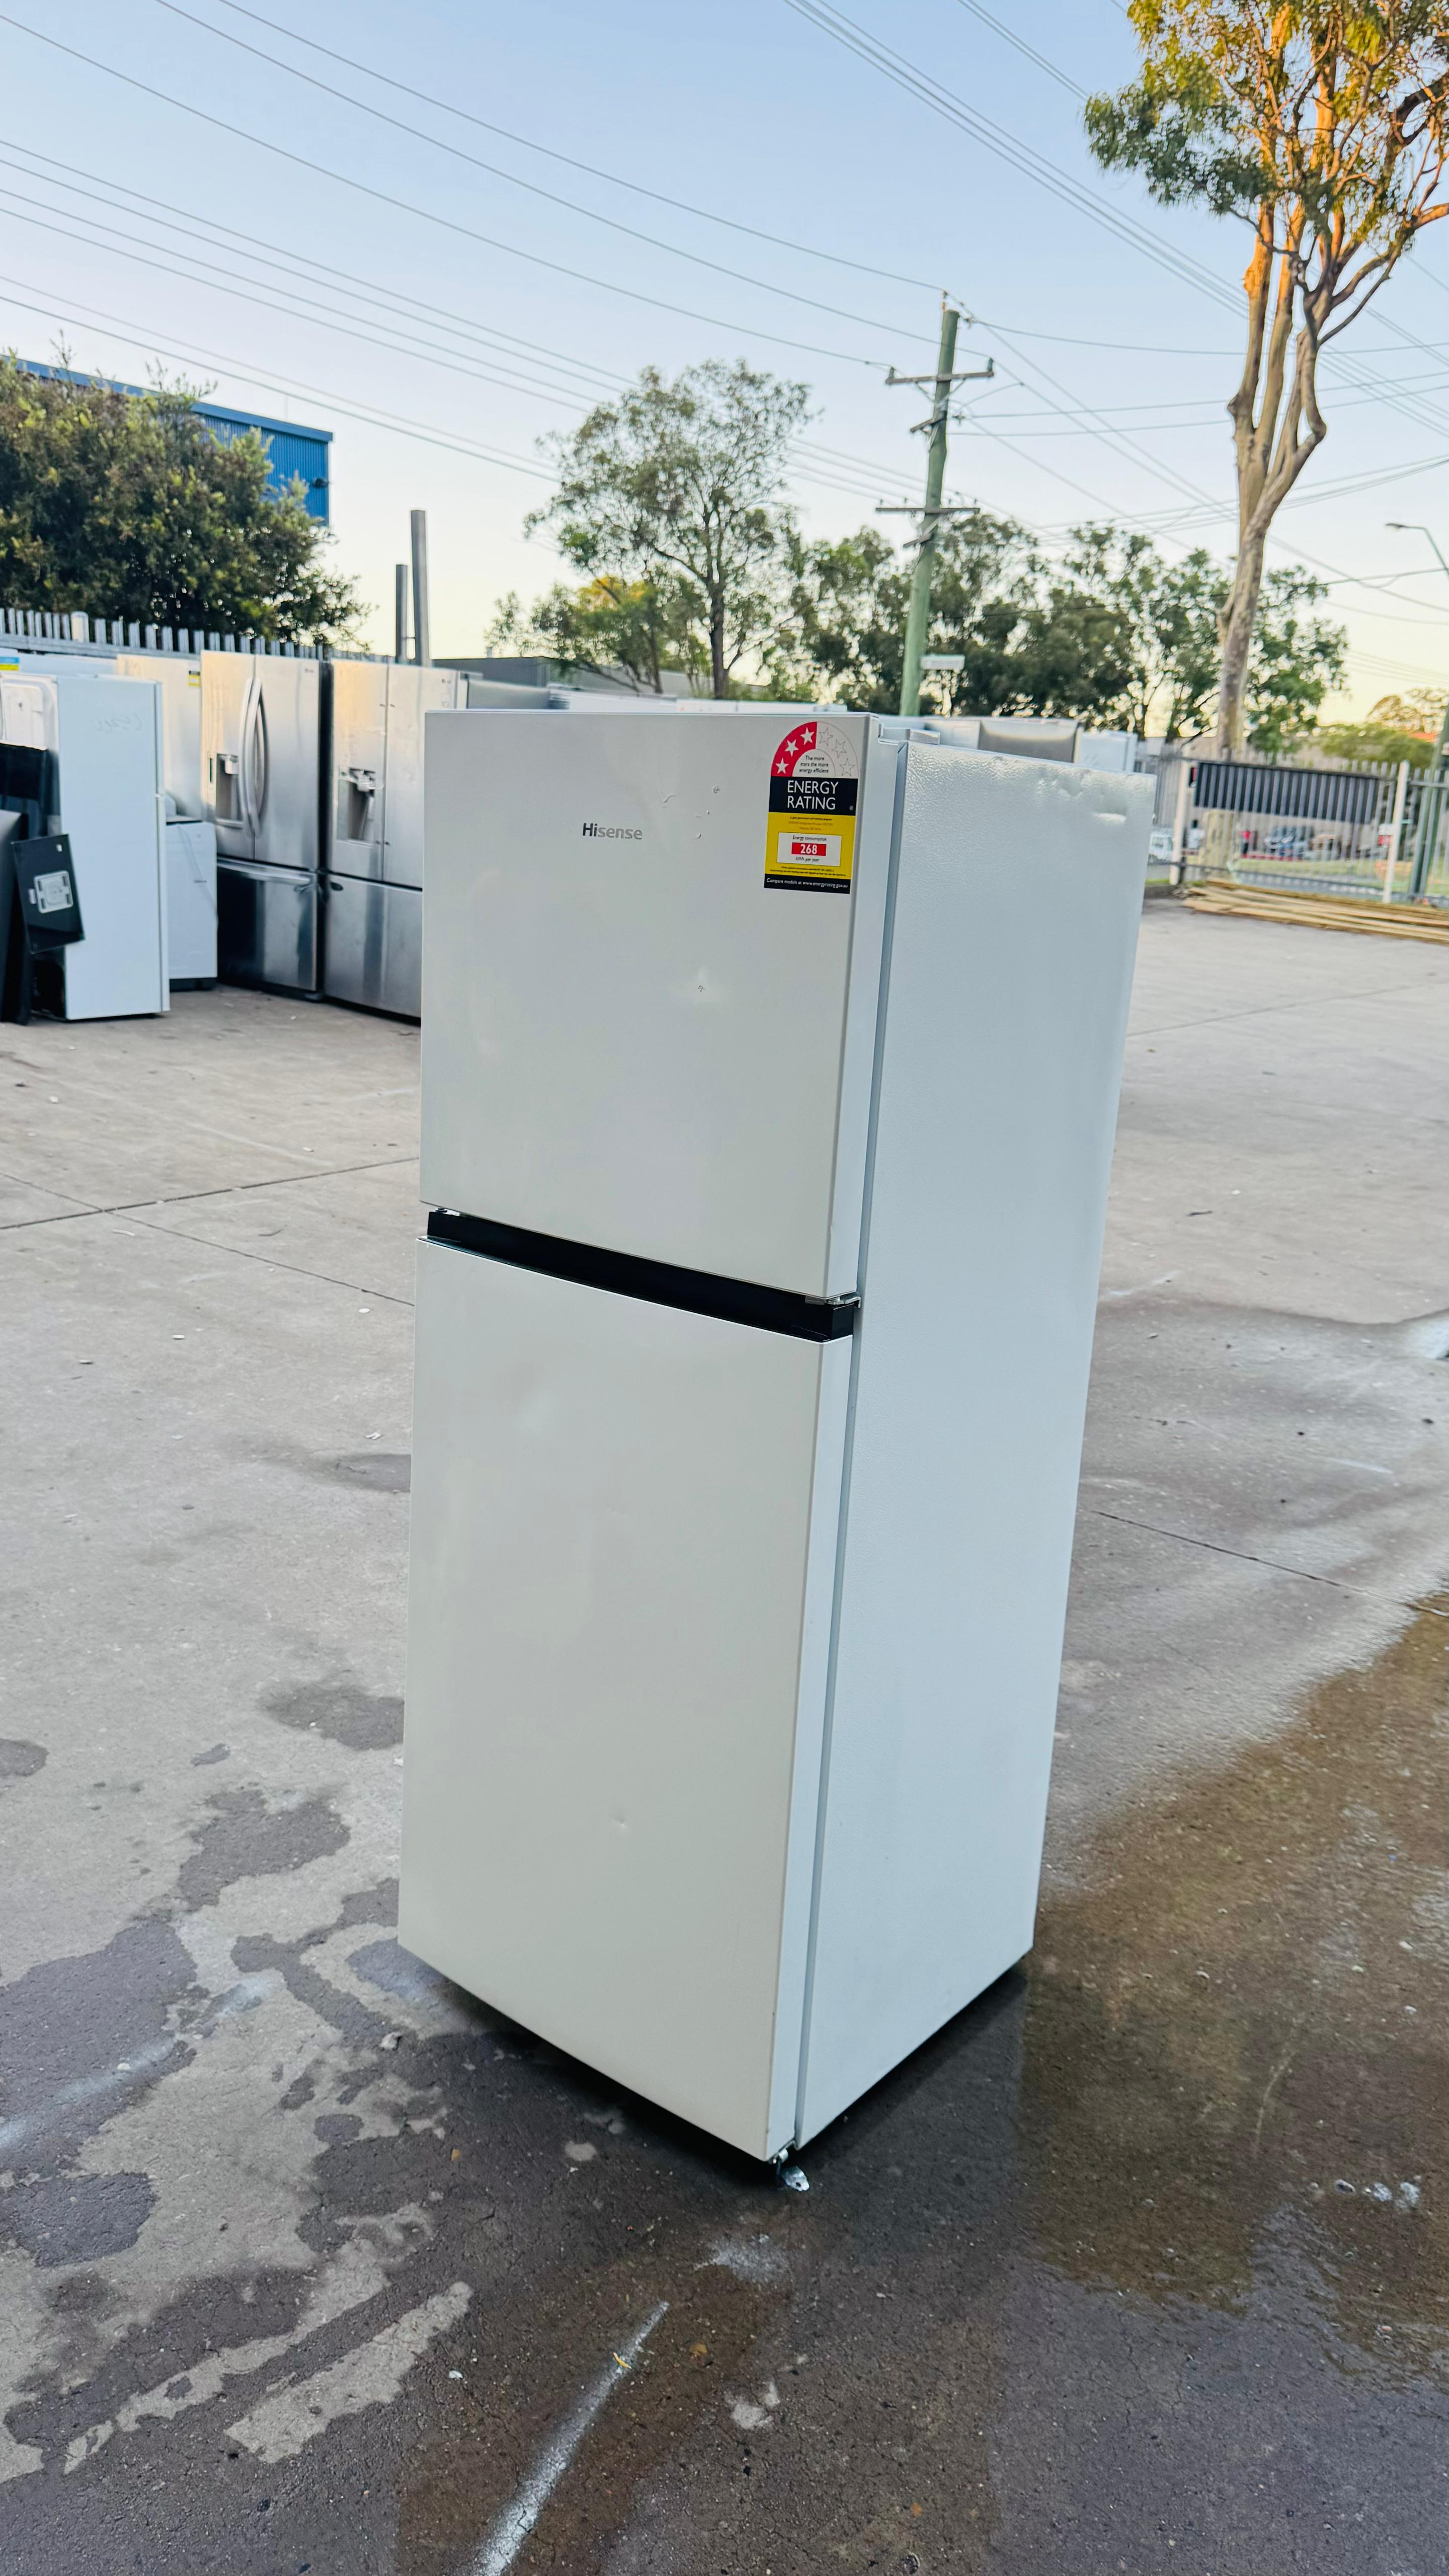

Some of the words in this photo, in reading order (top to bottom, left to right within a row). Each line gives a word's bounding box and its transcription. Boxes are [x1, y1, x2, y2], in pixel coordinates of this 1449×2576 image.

[787, 780, 839, 794] ENERGY
[787, 795, 836, 810] RATING
[582, 823, 642, 840] Hisense
[800, 844, 818, 854] 268
